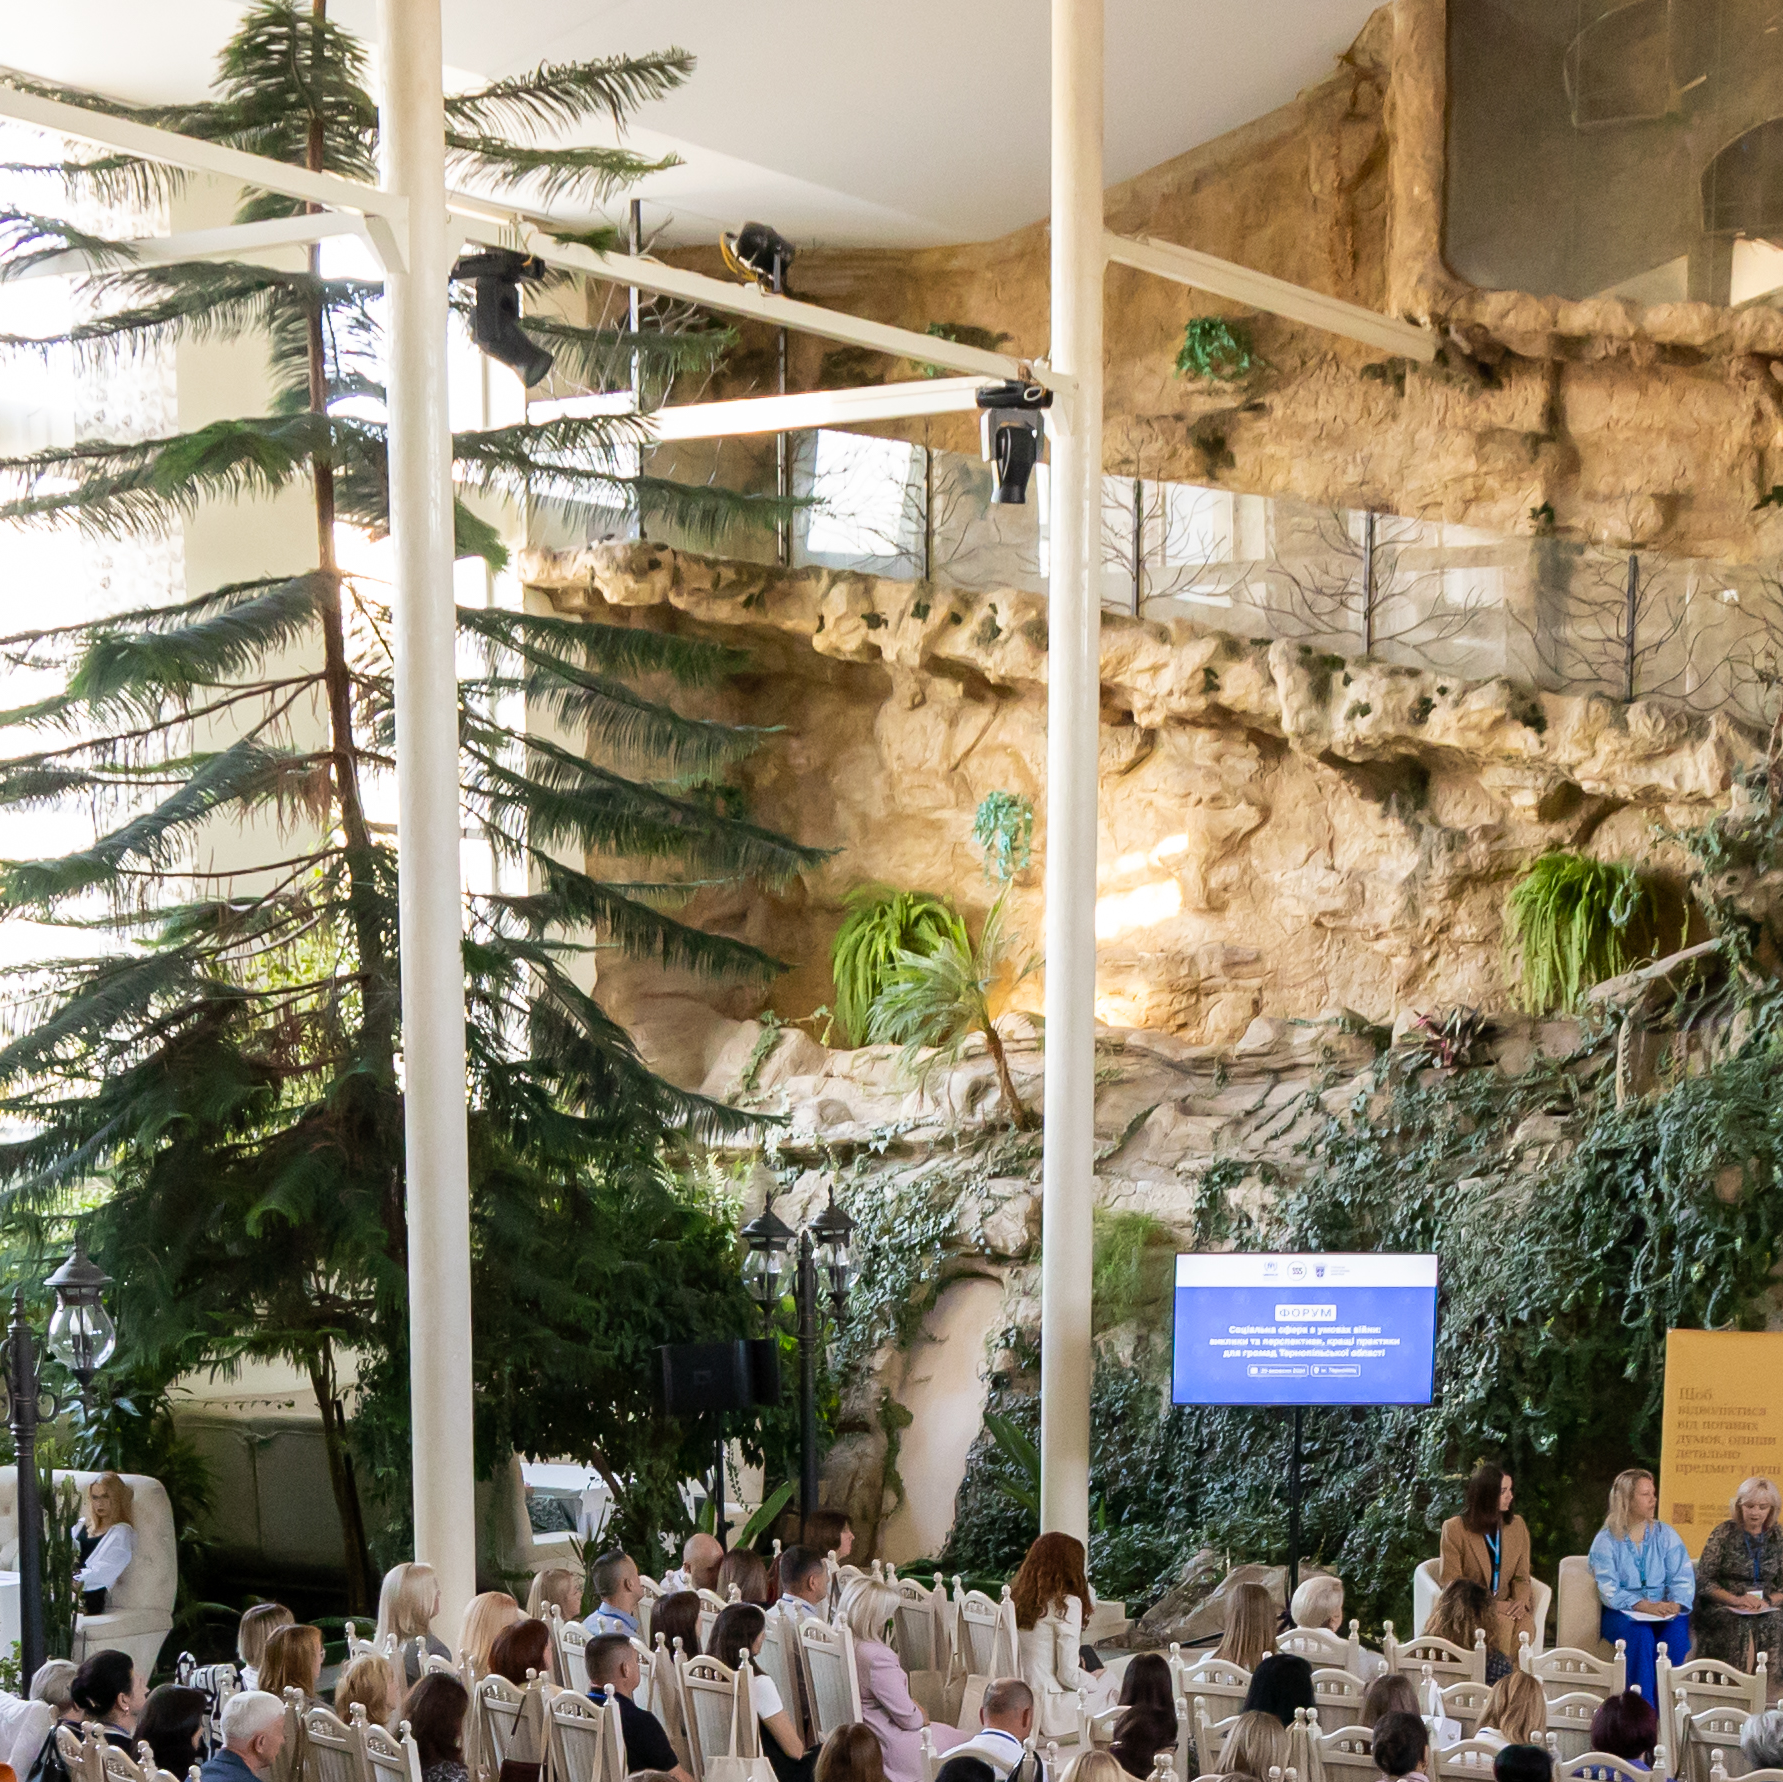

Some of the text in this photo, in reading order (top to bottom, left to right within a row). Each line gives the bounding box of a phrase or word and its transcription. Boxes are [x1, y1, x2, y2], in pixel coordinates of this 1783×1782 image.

[1279, 1308, 1332, 1318] ФОРУМ
[1679, 1387, 1713, 1401] Щоб
[1677, 1419, 1698, 1431] від
[1675, 1464, 1736, 1477] предмет
[1739, 1465, 1748, 1477] у
